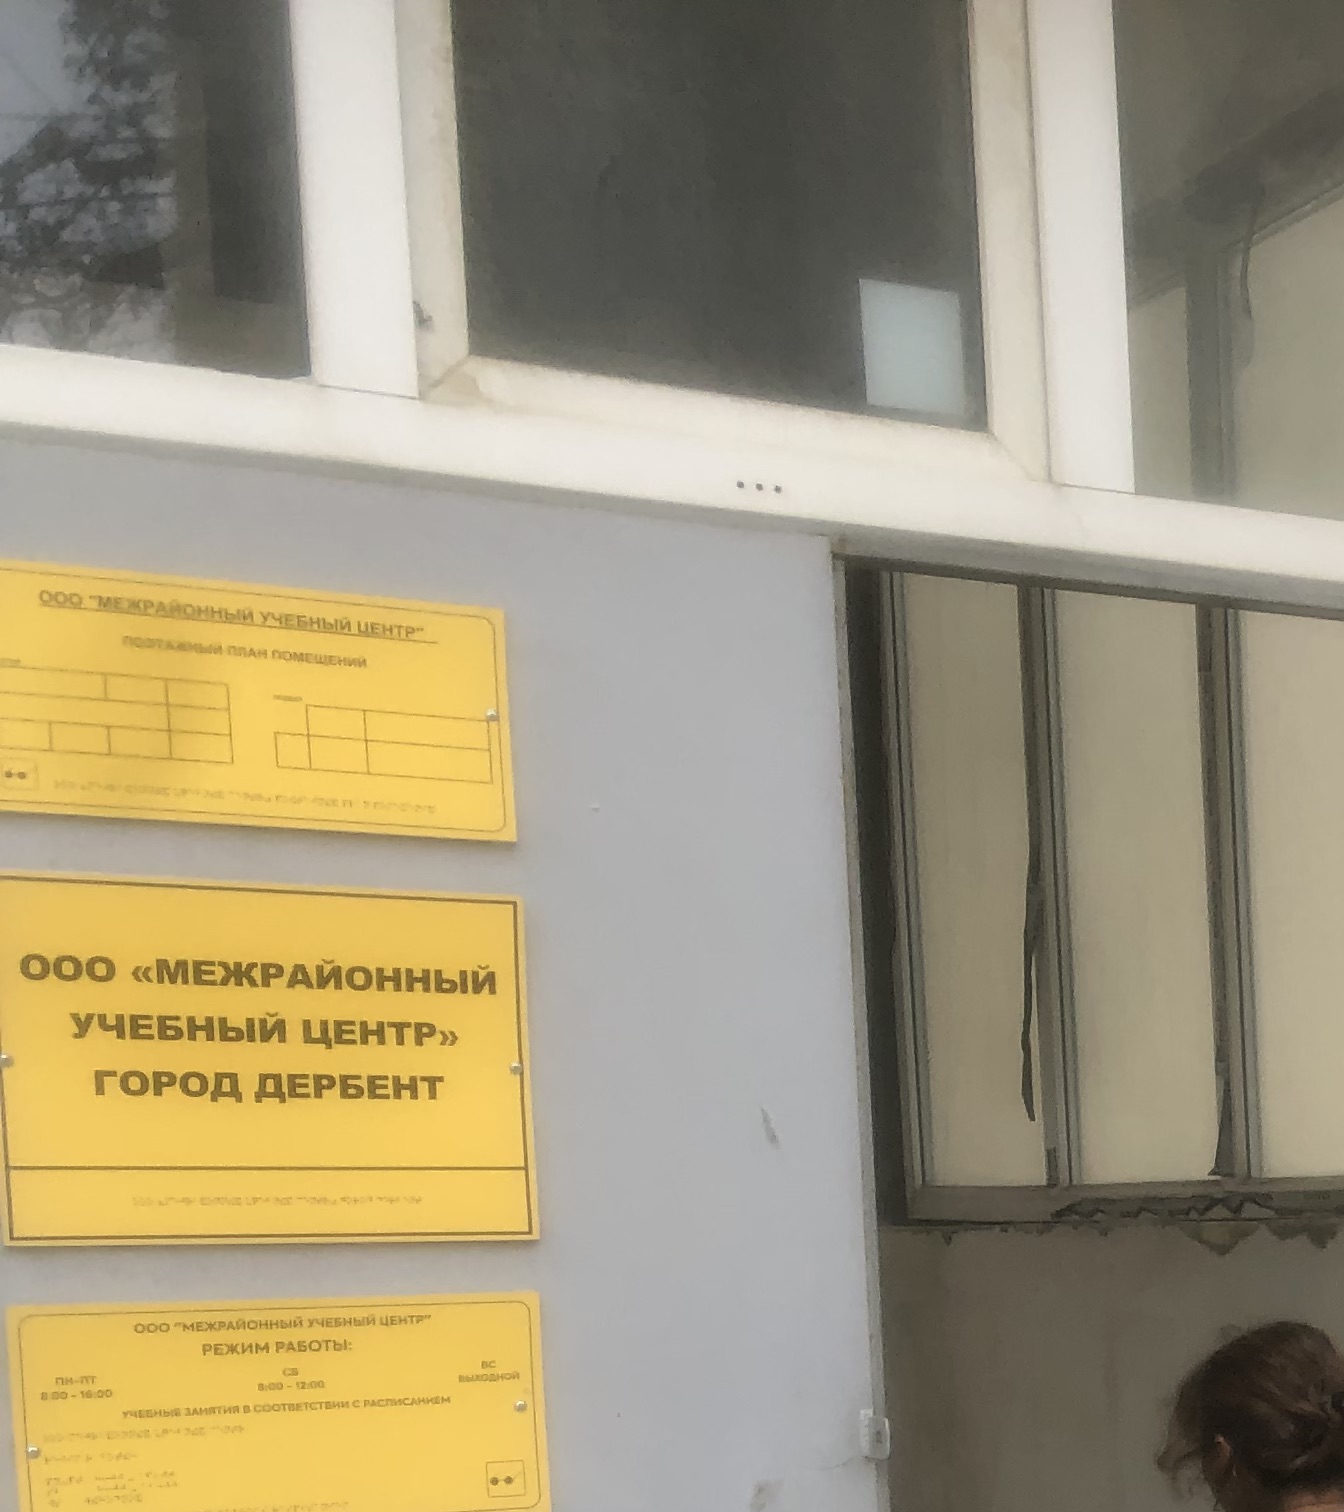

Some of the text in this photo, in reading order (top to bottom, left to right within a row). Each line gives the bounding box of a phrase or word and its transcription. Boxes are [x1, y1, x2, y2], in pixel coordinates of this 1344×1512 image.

[39, 589, 83, 608] ООО
[260, 609, 351, 633] УЧЕБНЫЙ
[227, 645, 267, 659] ПЛАН
[19, 953, 498, 995] ООО «МЕЖРАЙОННЫЙ
[69, 1011, 459, 1049] УЧЕБНЫЙ ЦЕНТР»
[94, 1069, 444, 1103] ГОРОД ДЕРБЕНТ
[133, 1322, 171, 1334] ООО
[307, 1314, 376, 1329] УЧЕБНЫЙ
[201, 1338, 353, 1356] РЕЖИМ РАБОТЫ:
[481, 1360, 497, 1370] ВС
